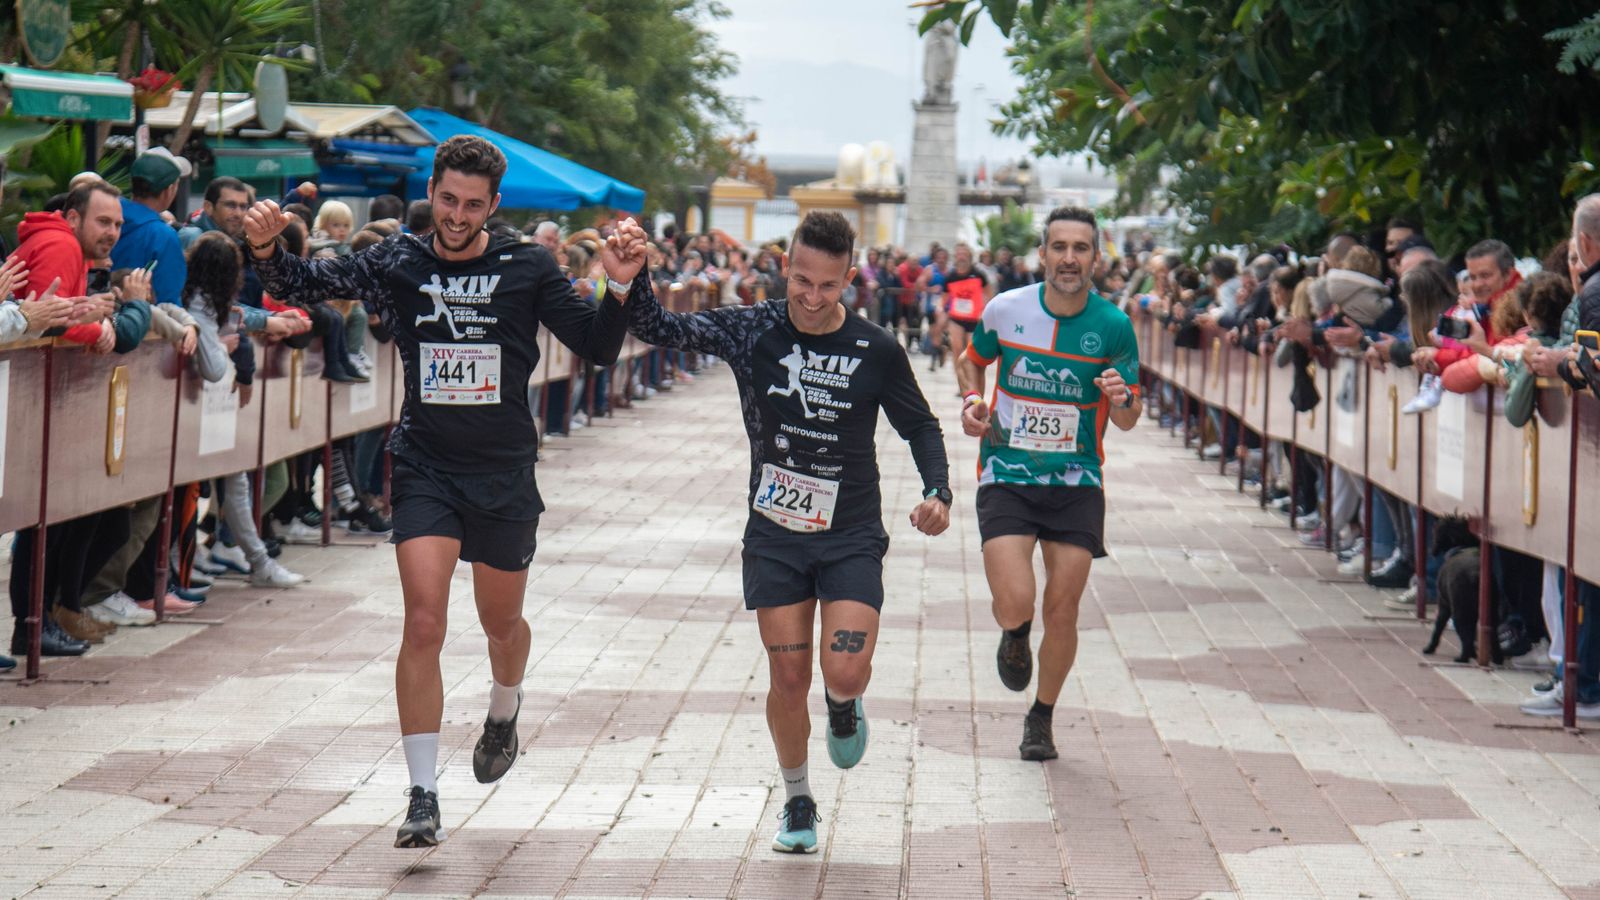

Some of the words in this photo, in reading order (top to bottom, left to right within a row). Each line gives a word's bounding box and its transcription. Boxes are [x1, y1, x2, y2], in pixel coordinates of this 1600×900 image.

[447, 275, 501, 293] XIV
[454, 316, 498, 324] SERRANO
[432, 348, 455, 360] XIV
[807, 350, 862, 375] XIV
[438, 360, 476, 383] 441
[802, 369, 846, 382] CARRERA
[800, 374, 849, 388] ESTRECHO
[1008, 375, 1056, 394] EURAFRICA
[807, 391, 832, 400] PEPE
[807, 396, 852, 409] SERRANO
[1024, 405, 1043, 415] XIV
[780, 423, 839, 442] metrovacesa
[1028, 415, 1061, 436] 253
[811, 463, 843, 472] Cruzcampo
[774, 470, 795, 486] XIV
[773, 484, 813, 514] 224
[830, 629, 868, 654] 35
